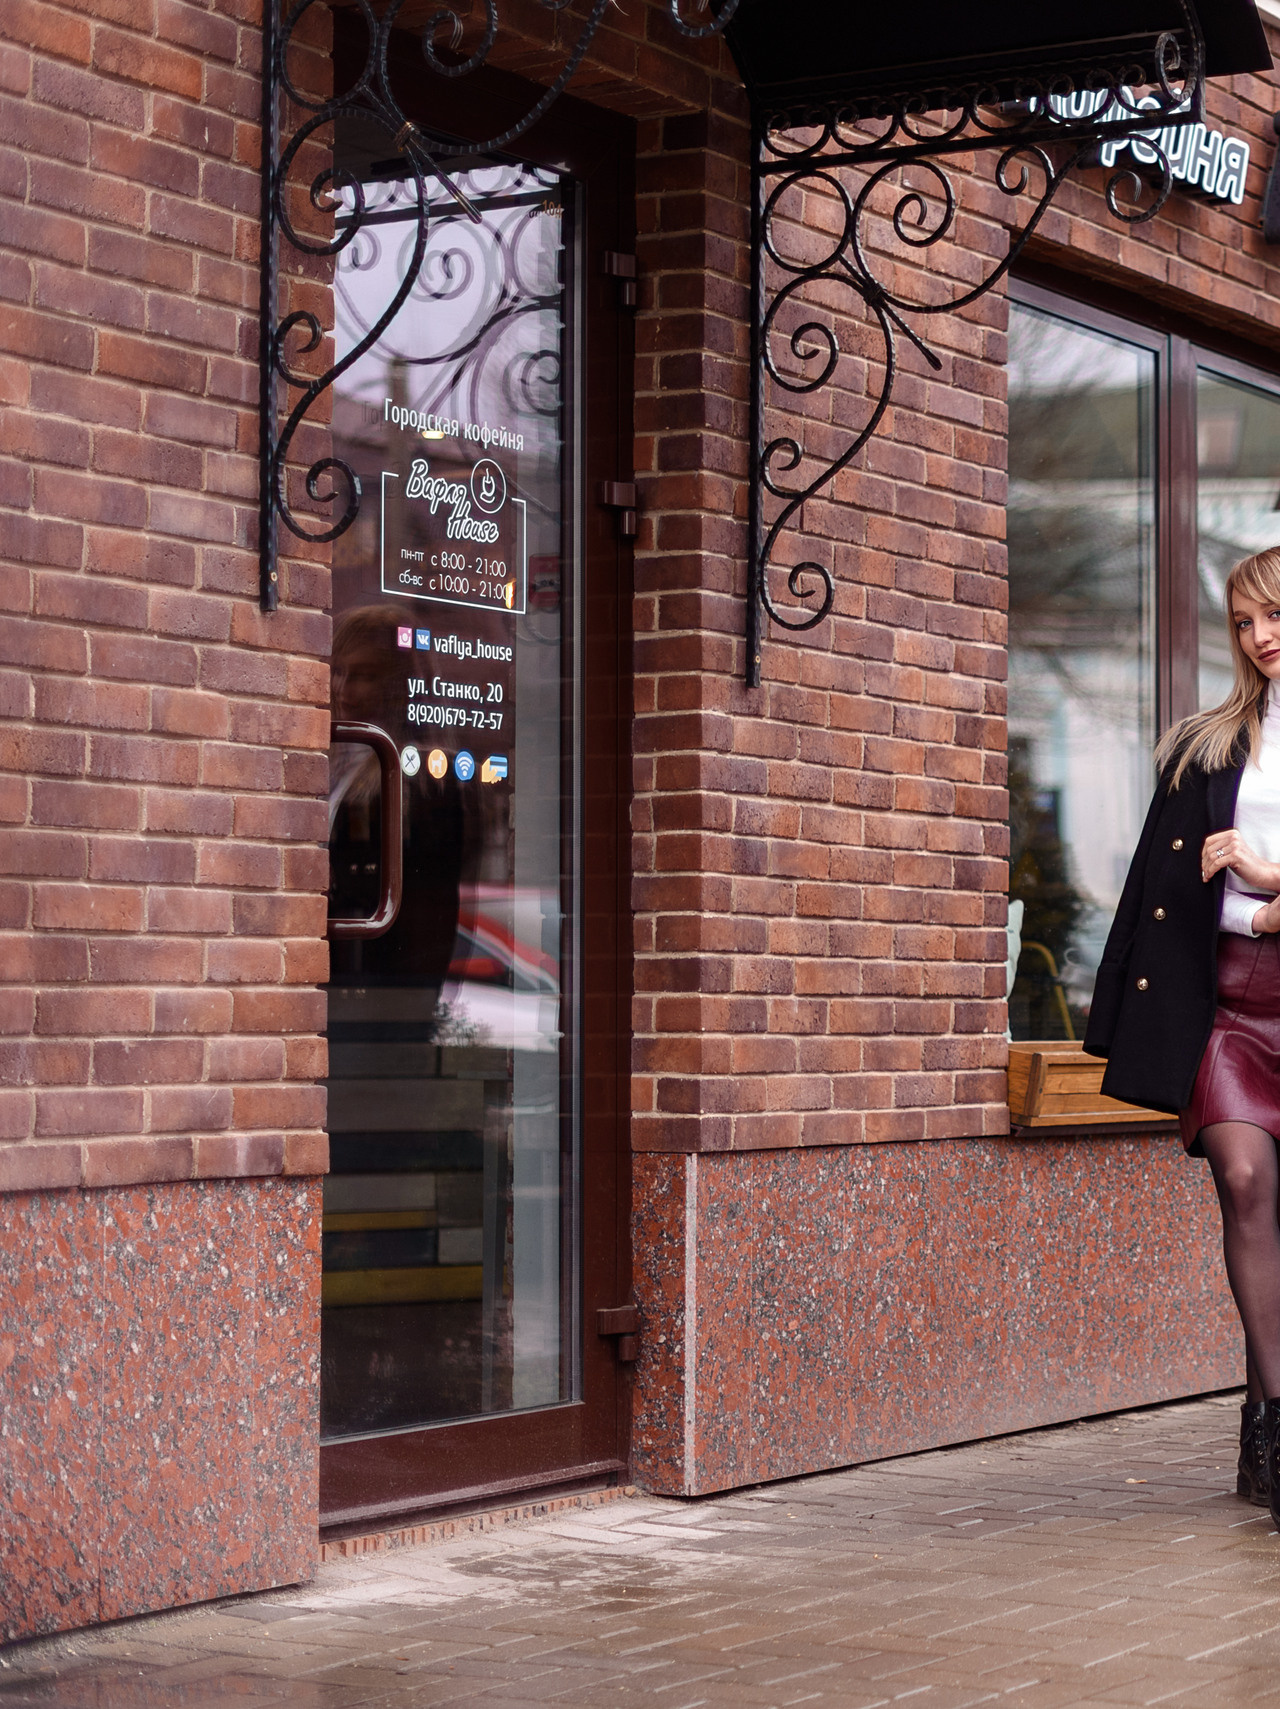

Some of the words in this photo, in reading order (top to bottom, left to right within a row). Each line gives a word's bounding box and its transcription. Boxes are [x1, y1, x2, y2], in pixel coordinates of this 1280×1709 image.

[384, 398, 459, 437] Городская
[464, 421, 524, 451] кофейня
[406, 458, 467, 515] Вафля
[446, 500, 500, 543] House
[400, 548, 424, 562] пн-пт
[430, 555, 438, 567] с
[440, 551, 466, 571] 8:00
[475, 557, 507, 578] 21:00
[399, 569, 423, 586] сб-вс
[429, 578, 436, 590] с
[439, 574, 470, 594] 10:00
[433, 634, 513, 662] vaflya_house
[407, 678, 429, 698] ул.
[432, 676, 484, 704] Станко,
[486, 682, 504, 704] 20
[407, 703, 504, 730] 8(920)679-72-57
